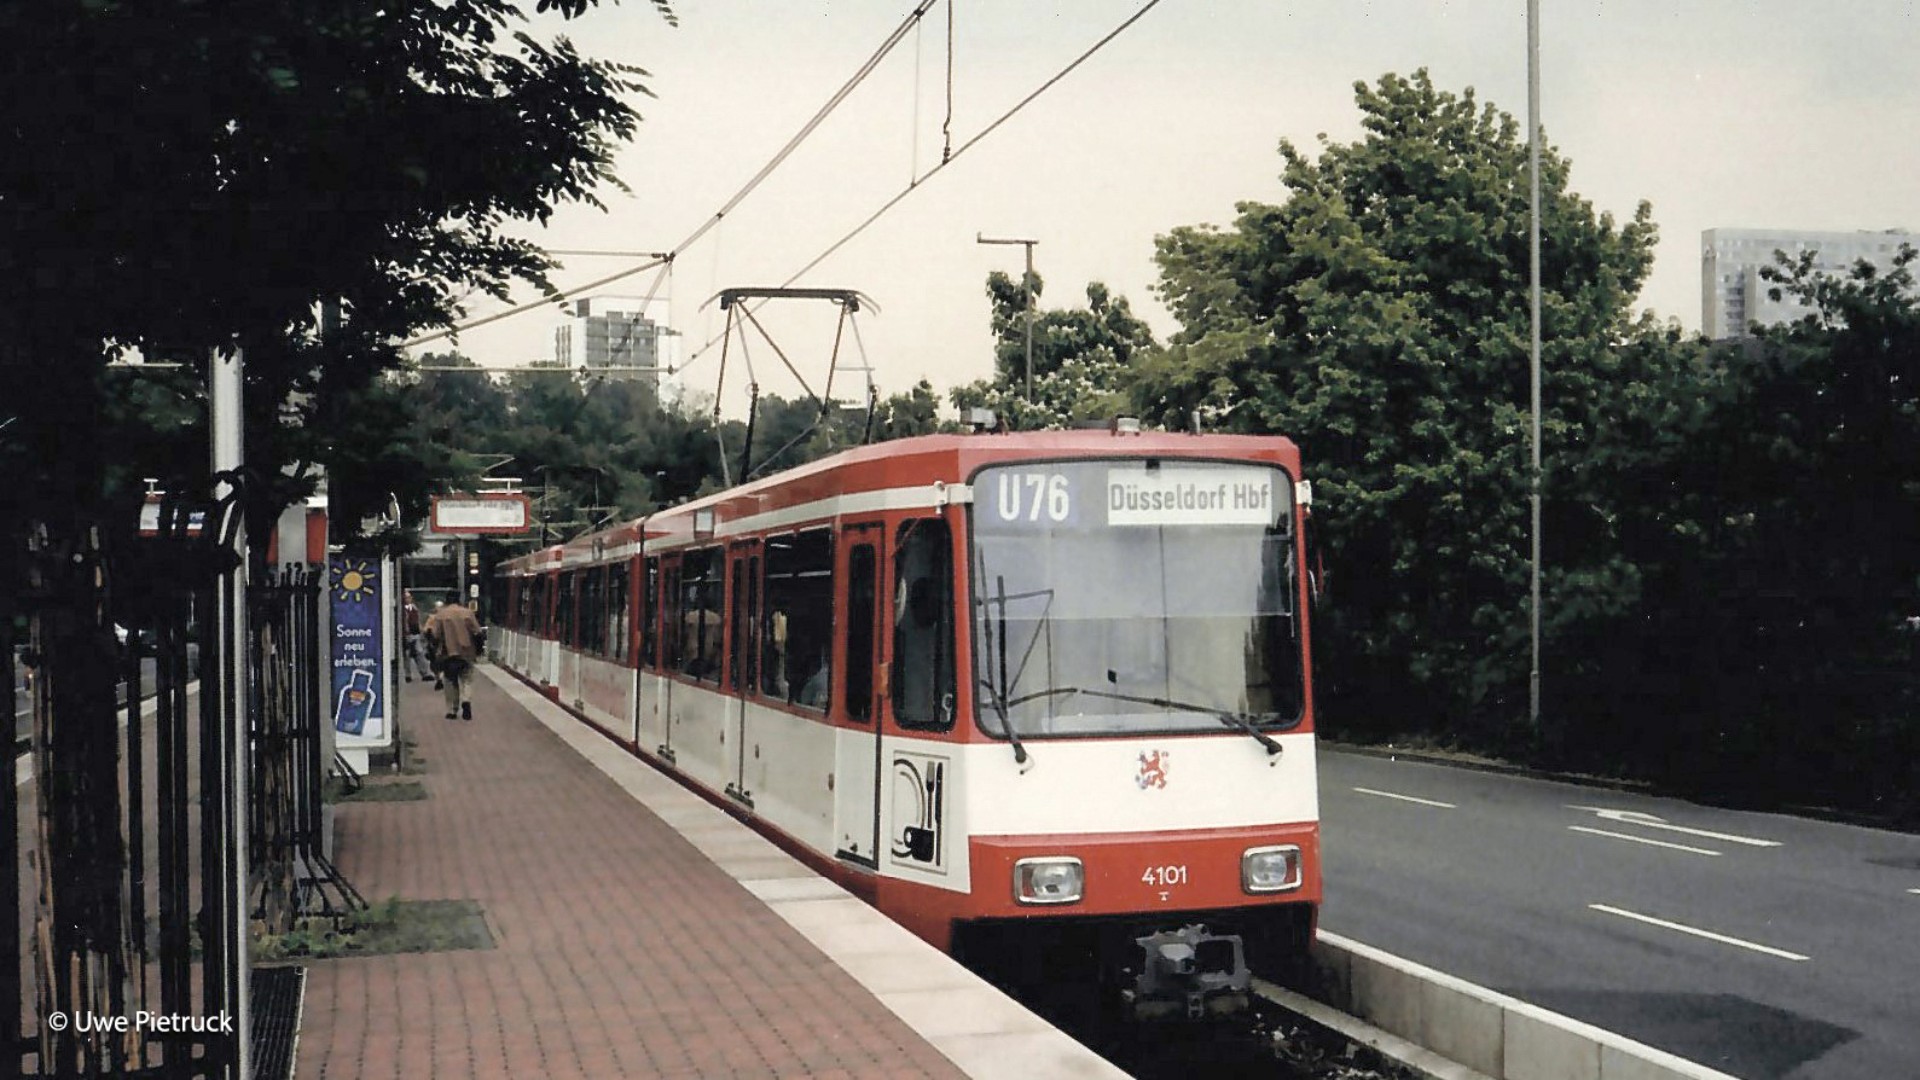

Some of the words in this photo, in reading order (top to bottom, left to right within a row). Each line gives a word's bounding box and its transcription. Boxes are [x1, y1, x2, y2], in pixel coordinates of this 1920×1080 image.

[998, 473, 1070, 522] U76
[1110, 483, 1226, 511] Düsseldorf
[1233, 483, 1270, 508] Hbf
[336, 623, 372, 637] Sonne
[343, 642, 365, 652] neu
[333, 653, 377, 668] erleben.
[1141, 865, 1187, 886] 4101
